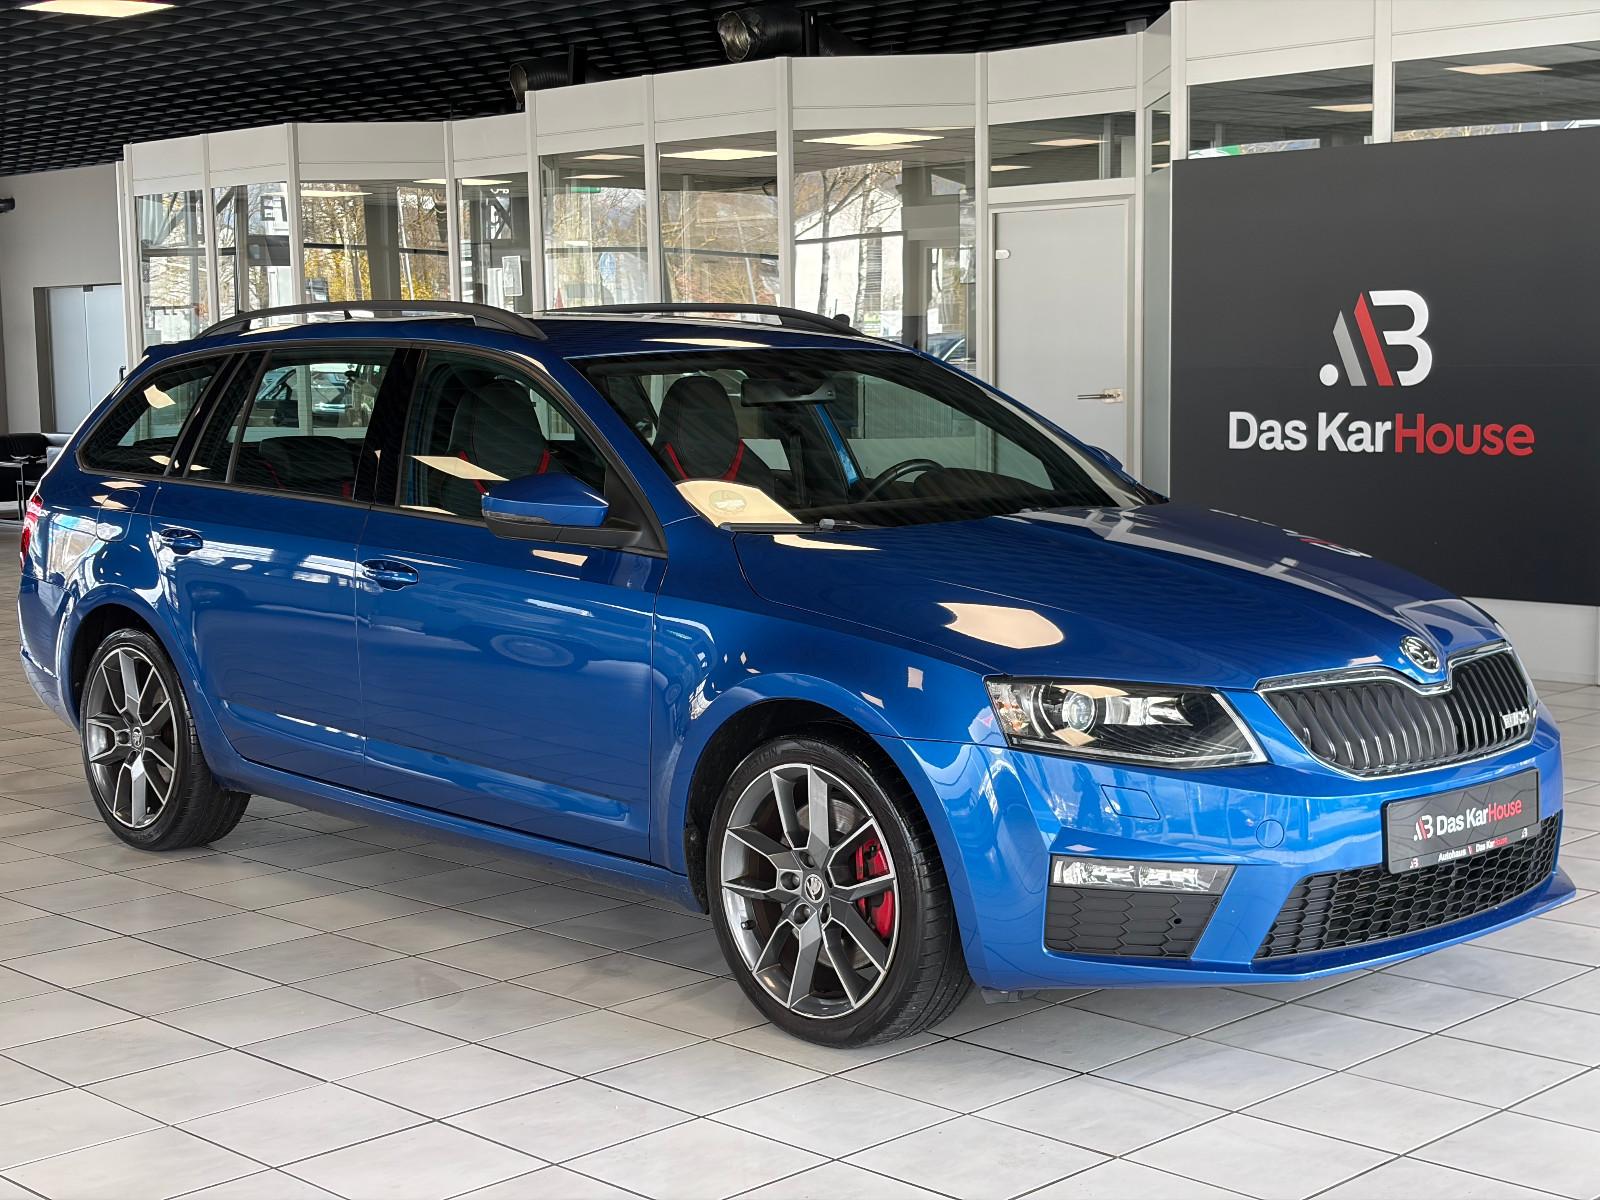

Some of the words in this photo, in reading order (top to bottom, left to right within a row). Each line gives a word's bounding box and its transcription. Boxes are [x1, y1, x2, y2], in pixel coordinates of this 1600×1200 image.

[1228, 410, 1308, 452] Das
[1317, 411, 1536, 457] KarHouse
[1436, 814, 1465, 836] Das
[1437, 848, 1467, 862] Autohaus
